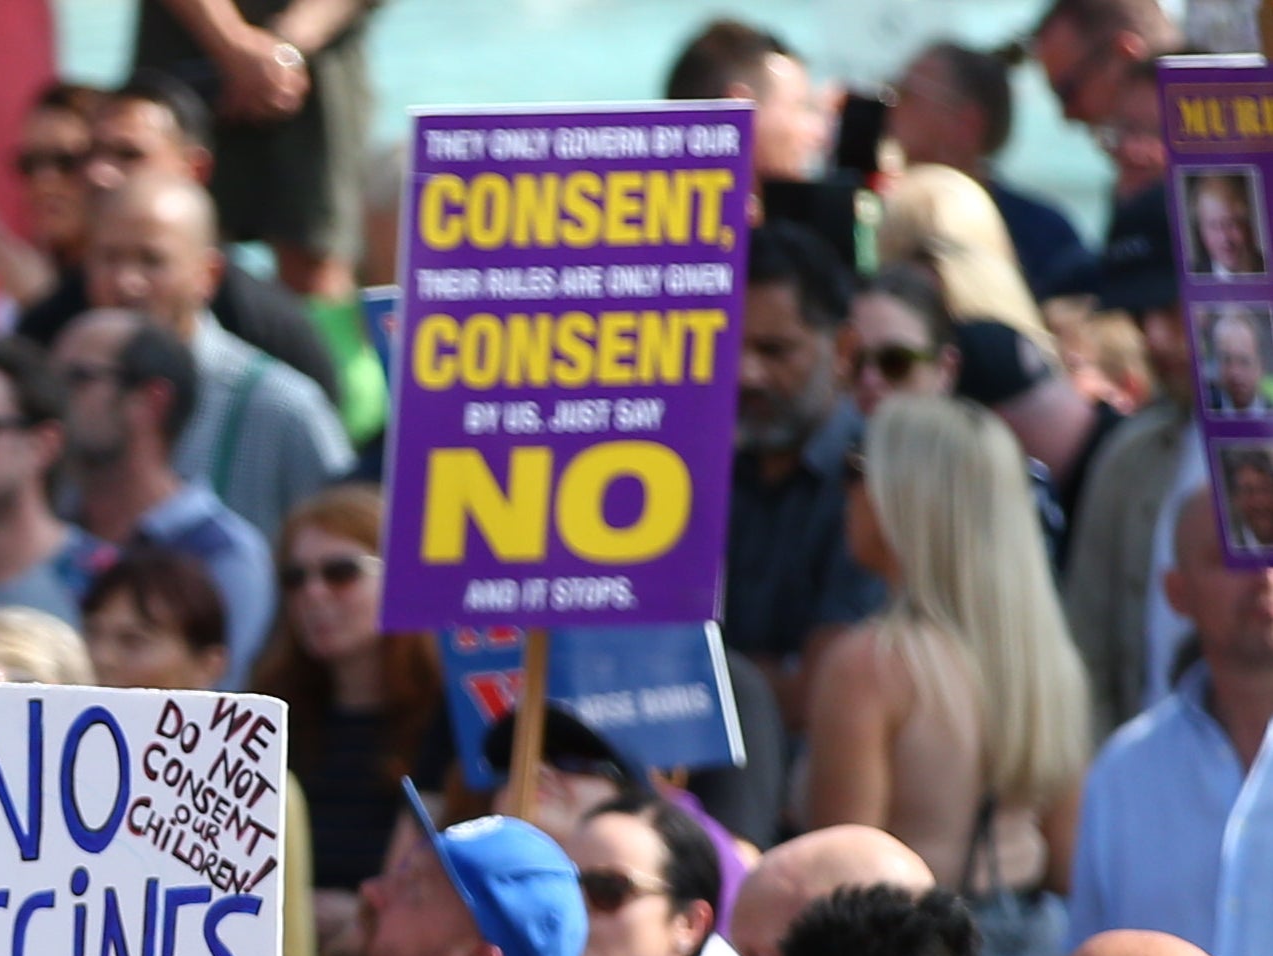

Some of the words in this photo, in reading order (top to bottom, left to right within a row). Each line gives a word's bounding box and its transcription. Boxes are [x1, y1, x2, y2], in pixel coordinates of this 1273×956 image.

[423, 128, 486, 162] THEY
[488, 127, 551, 161] ONLY
[553, 126, 649, 160] GOVERN
[651, 124, 685, 158] BY
[686, 123, 740, 157] OUR
[419, 168, 735, 252] CONSENT,
[416, 267, 481, 300] THEIR
[483, 265, 557, 299] RULES
[559, 265, 602, 298] ARE
[603, 264, 661, 297] ONLY
[663, 262, 733, 296] GIVEN
[413, 311, 726, 389] CONSENT
[463, 401, 500, 435] BY
[547, 398, 612, 433] JUST
[612, 397, 666, 432] SAY
[421, 440, 693, 564] NO
[463, 578, 520, 613] AND
[522, 578, 549, 612] IT
[156, 699, 200, 753] DO
[208, 748, 277, 808] NOT
[210, 698, 277, 763] WE
[143, 742, 277, 856] CONSENT
